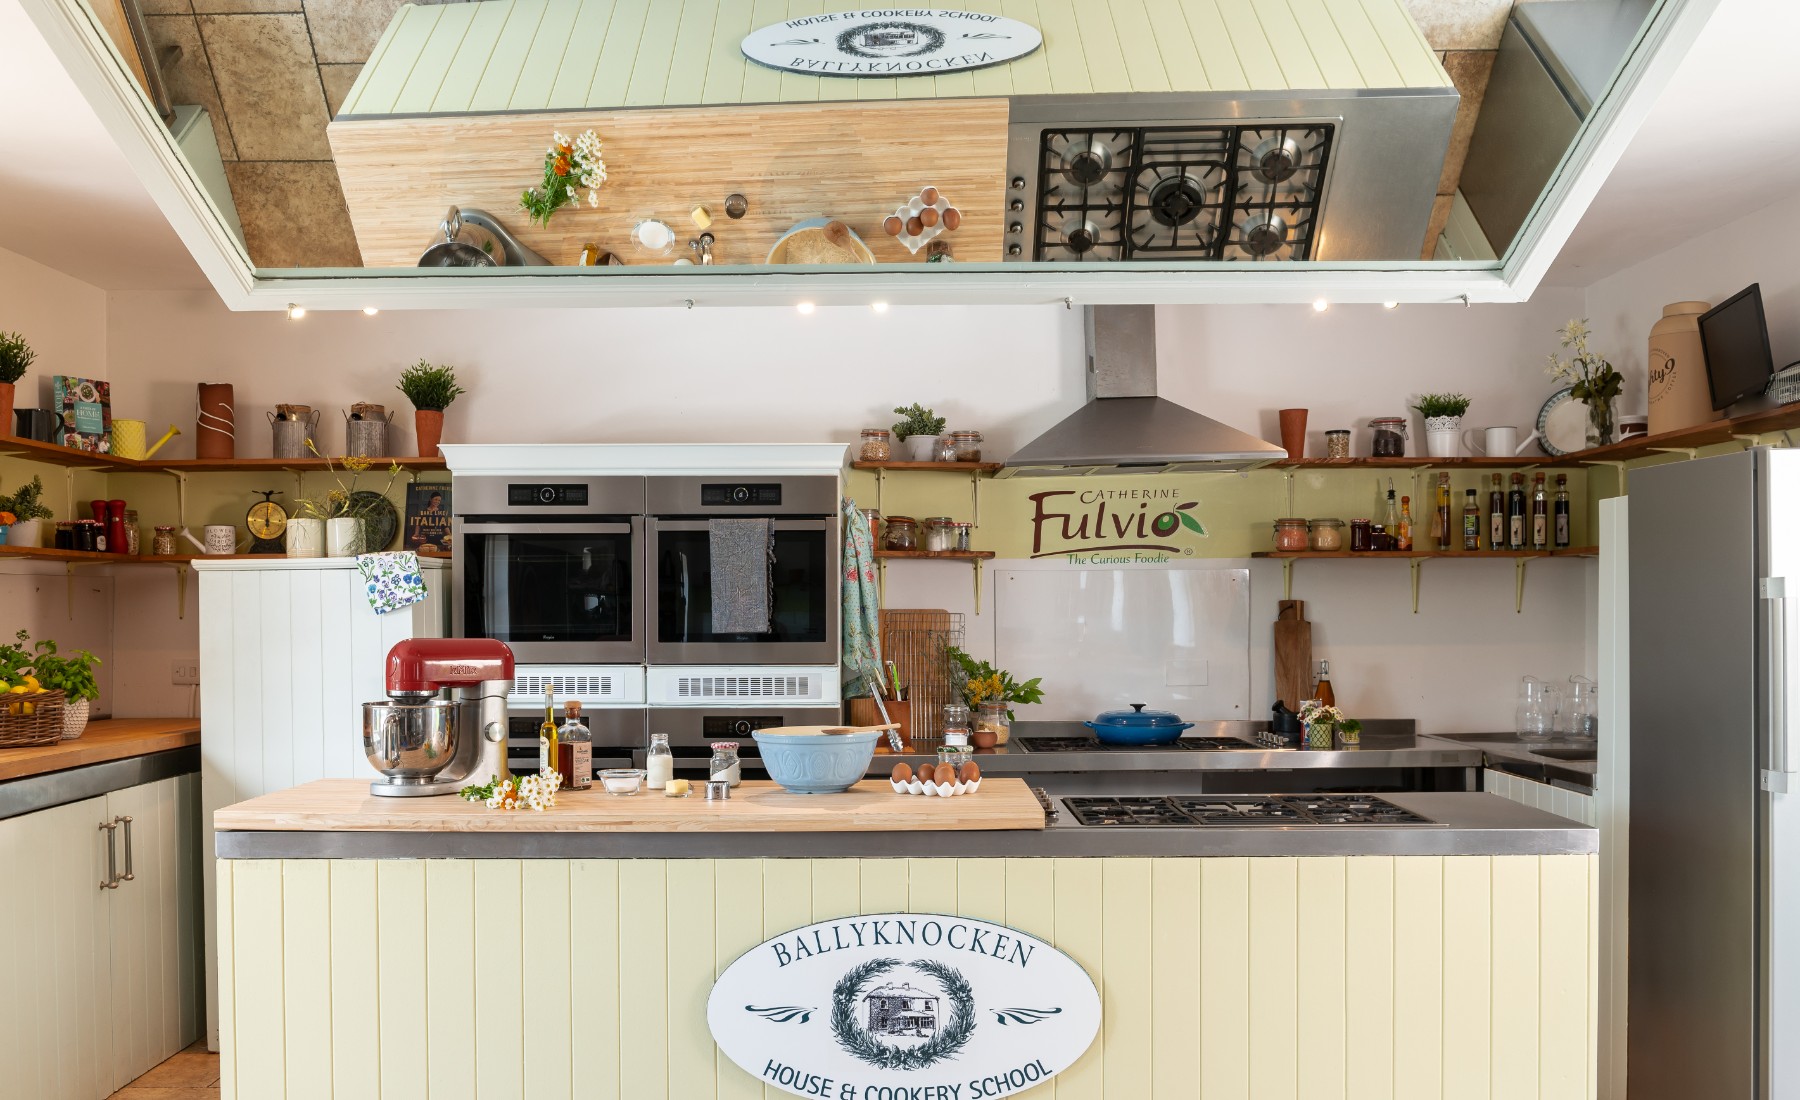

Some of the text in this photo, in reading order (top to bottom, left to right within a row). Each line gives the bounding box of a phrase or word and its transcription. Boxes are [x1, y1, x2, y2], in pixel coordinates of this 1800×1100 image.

[1080, 489, 1180, 504] CATHERINE
[1028, 490, 1181, 554] Fulvio
[1066, 552, 1170, 565] The Curious Foodie
[771, 920, 1036, 969] BALLYKNOCKEN
[762, 1058, 1053, 1100] HOUSE & COOKERY SCHOOL
